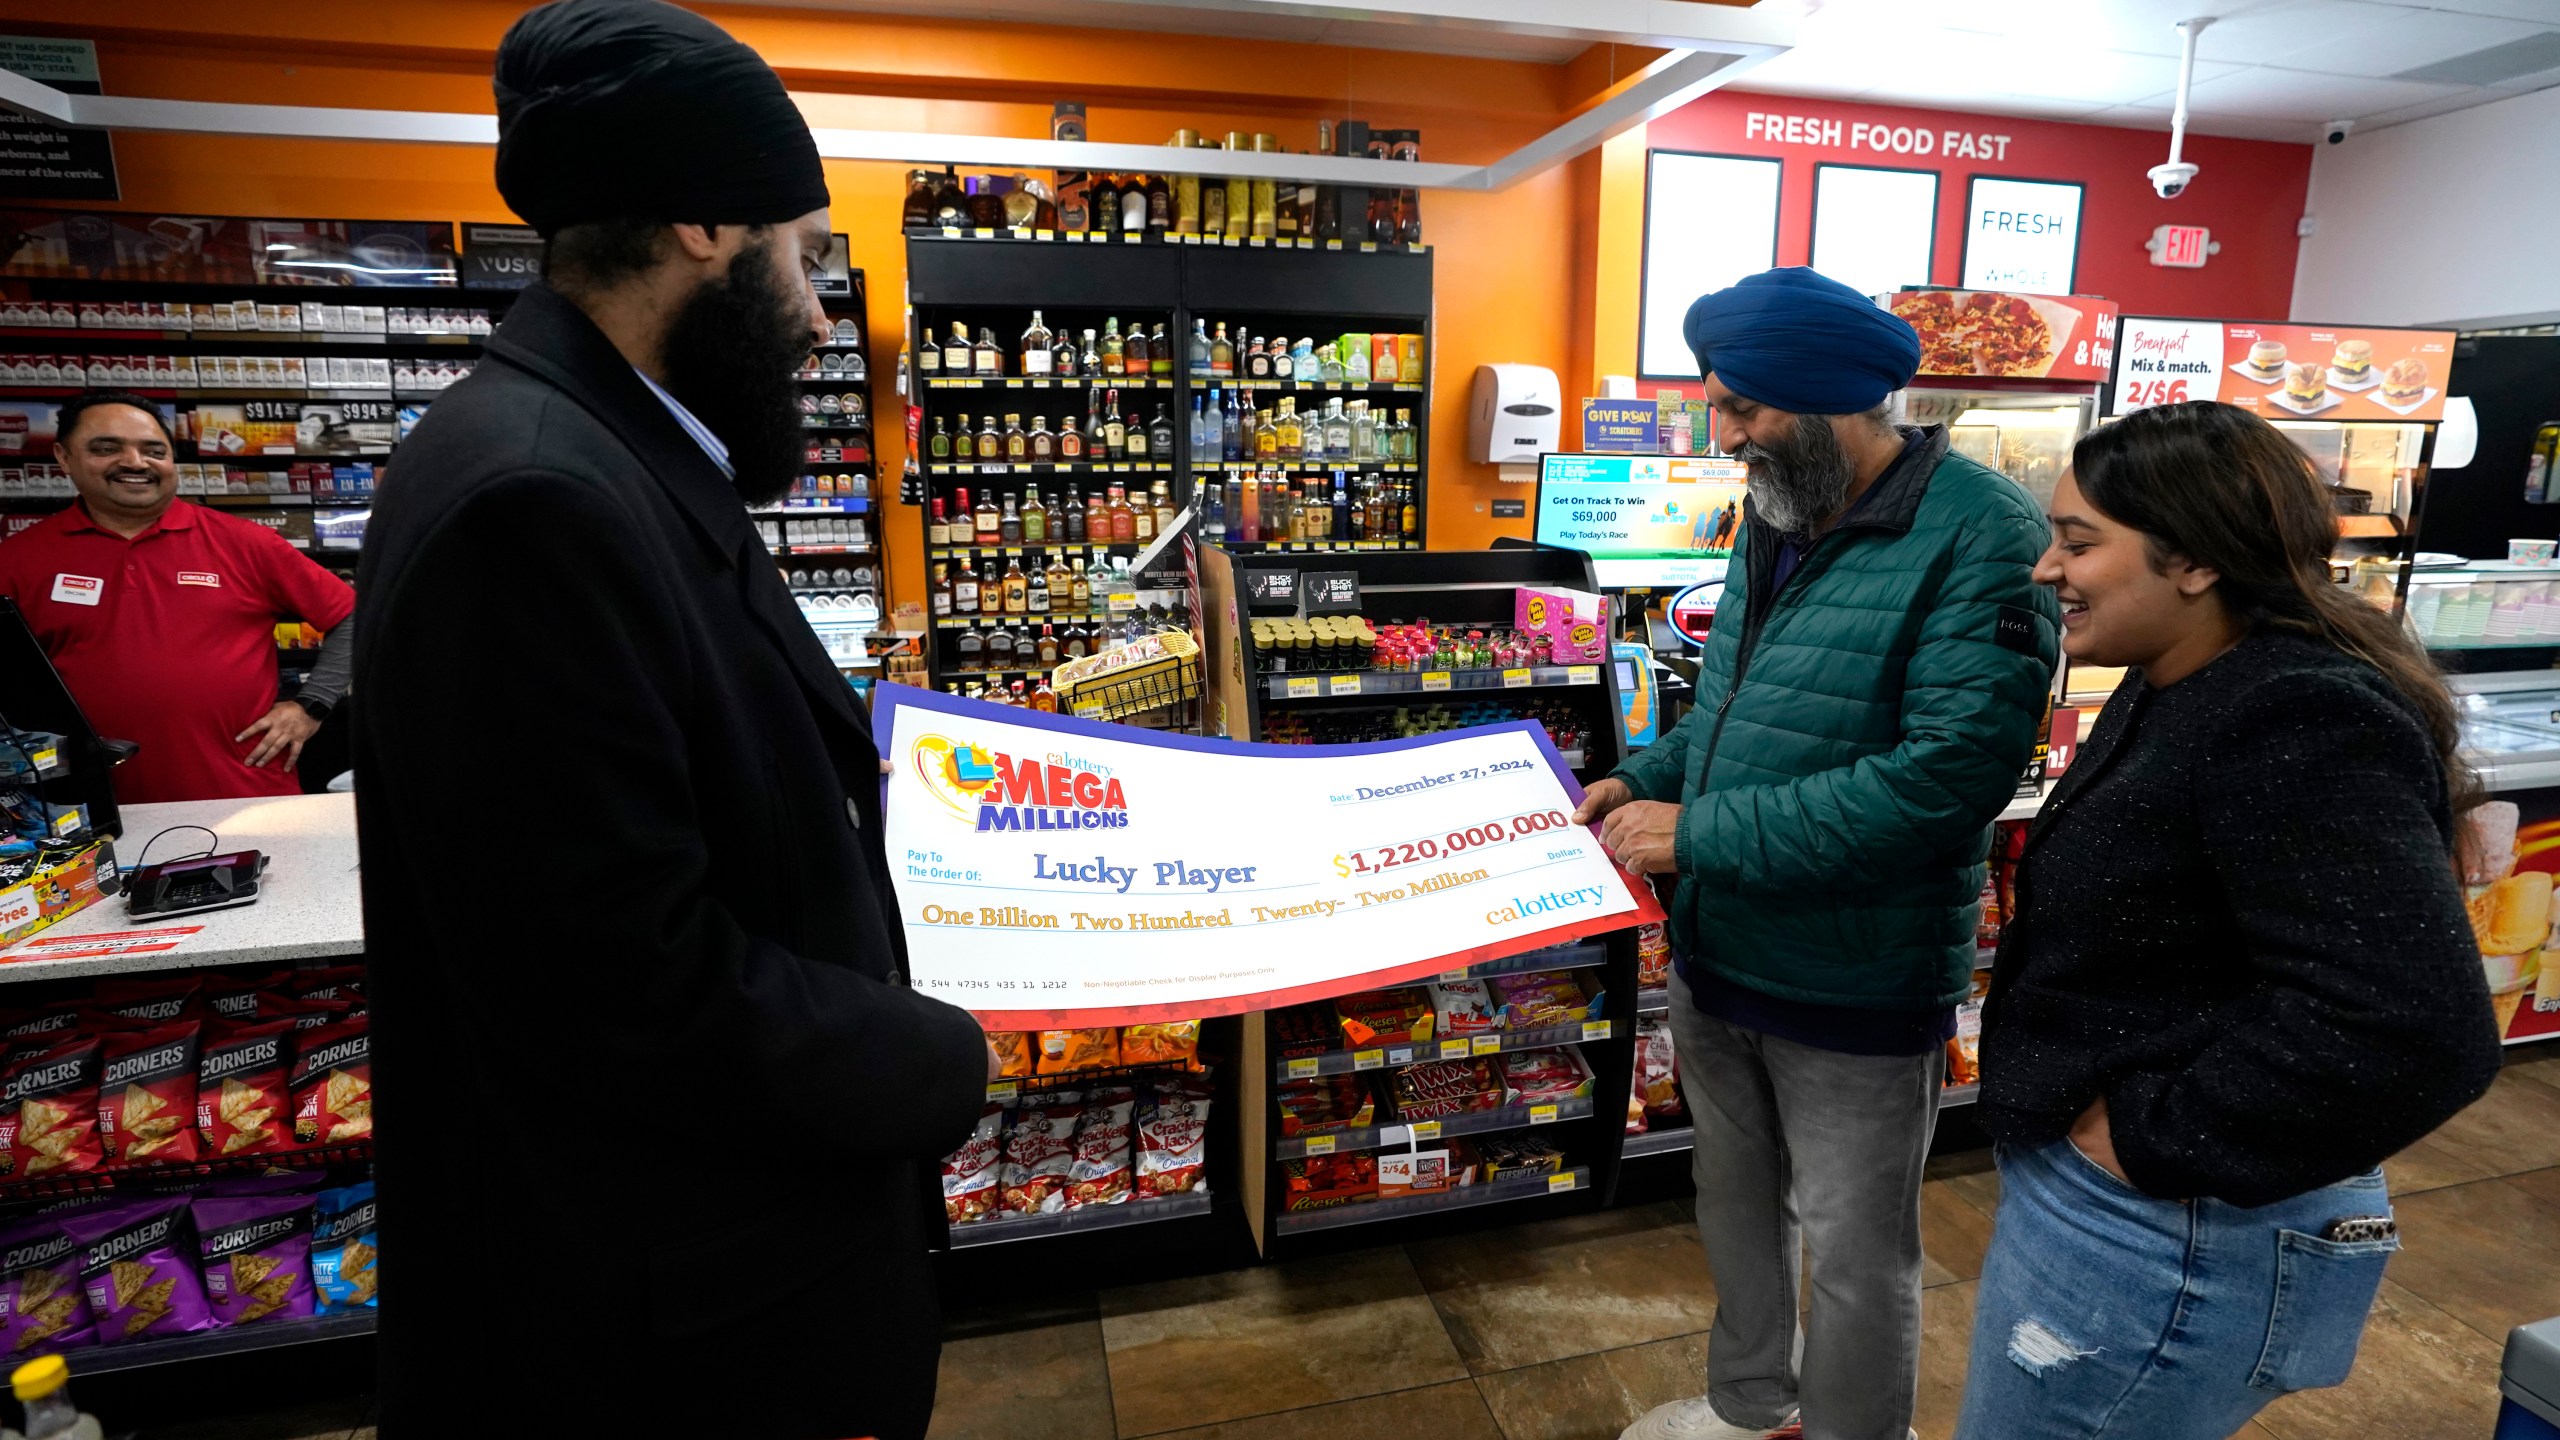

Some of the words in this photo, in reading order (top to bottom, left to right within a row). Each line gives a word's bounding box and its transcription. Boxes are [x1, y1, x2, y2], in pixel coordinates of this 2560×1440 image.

[13, 132, 54, 145] weight
[56, 133, 69, 143] in
[1746, 112, 1842, 147] FRESH
[1850, 122, 1935, 155] FOOD
[1942, 131, 2012, 161] FAST
[48, 151, 70, 160] and
[29, 167, 43, 178] of
[43, 168, 63, 178] the
[1982, 210, 2062, 235] FRESH
[2165, 228, 2204, 264] EXIT
[2133, 328, 2190, 360] Breakfast
[2074, 346, 2089, 366] &
[2131, 358, 2154, 373] Mix
[2156, 361, 2166, 373] &
[2168, 361, 2212, 374] match.
[2127, 378, 2189, 404] 2/$6
[1588, 410, 1619, 423] GIVE
[1621, 410, 1653, 424] PLAY
[1609, 426, 1643, 436] SCRATCHERS
[1702, 469, 1730, 477] $69,000
[1553, 497, 1568, 505] Get
[1571, 497, 1584, 505] On
[1587, 497, 1611, 505] Track
[1614, 497, 1625, 505] To
[1627, 497, 1645, 505] Win
[1571, 511, 1617, 523] $69,000
[1560, 531, 1577, 541] Play
[1579, 531, 1607, 541] Today's
[1609, 531, 1629, 539] Race
[64, 579, 84, 587] CIRCLE
[1046, 752, 1114, 779] calottery
[982, 752, 1128, 811] MEGA
[1330, 793, 1355, 803] Date:
[1356, 773, 1455, 801] December
[1460, 767, 1487, 782] 27,
[1489, 759, 1534, 773] 2024
[976, 805, 1129, 832] MILLIONS
[908, 850, 927, 863] Pay
[929, 851, 943, 863] To
[1547, 847, 1583, 861] Dollars
[97, 861, 113, 874] KING
[98, 869, 116, 883] SIZE
[908, 865, 927, 877] The
[930, 867, 963, 881] Order
[966, 870, 982, 882] Of:
[1034, 854, 1138, 894] Lucky
[1153, 860, 1257, 893] Player
[922, 904, 975, 926] One
[979, 906, 1060, 928] Billion
[1070, 912, 1124, 931] Two
[1128, 909, 1234, 931] Hundred
[1354, 887, 1405, 907] Two
[1407, 867, 1490, 897] Million
[1486, 885, 1605, 926] calottery
[931, 979, 950, 989] 544
[957, 979, 990, 989] 47345
[997, 979, 1016, 989] 435
[1023, 979, 1035, 989] 11
[1042, 980, 1068, 989] 1212
[1084, 977, 1147, 989] Non-Negotiable
[1148, 976, 1172, 985] Check
[1173, 975, 1186, 984] for
[1188, 973, 1217, 984] Display
[1219, 968, 1255, 980] Purposes
[1257, 966, 1276, 978] Only
[1438, 982, 1480, 993] Kinder
[105, 1045, 184, 1082] CORNERS
[201, 1039, 277, 1077] CORNERS
[1405, 1060, 1472, 1092] TWIX
[1076, 1124, 1127, 1145] Cracker
[1159, 1132, 1195, 1151] Jack
[1079, 1140, 1112, 1161] Jack
[1085, 1160, 1119, 1179] Original
[1162, 1152, 1199, 1170] Original
[1382, 1163, 1410, 1177] 2/$4
[89, 1218, 170, 1265] CORNERS
[211, 1216, 294, 1252] CORNERS
